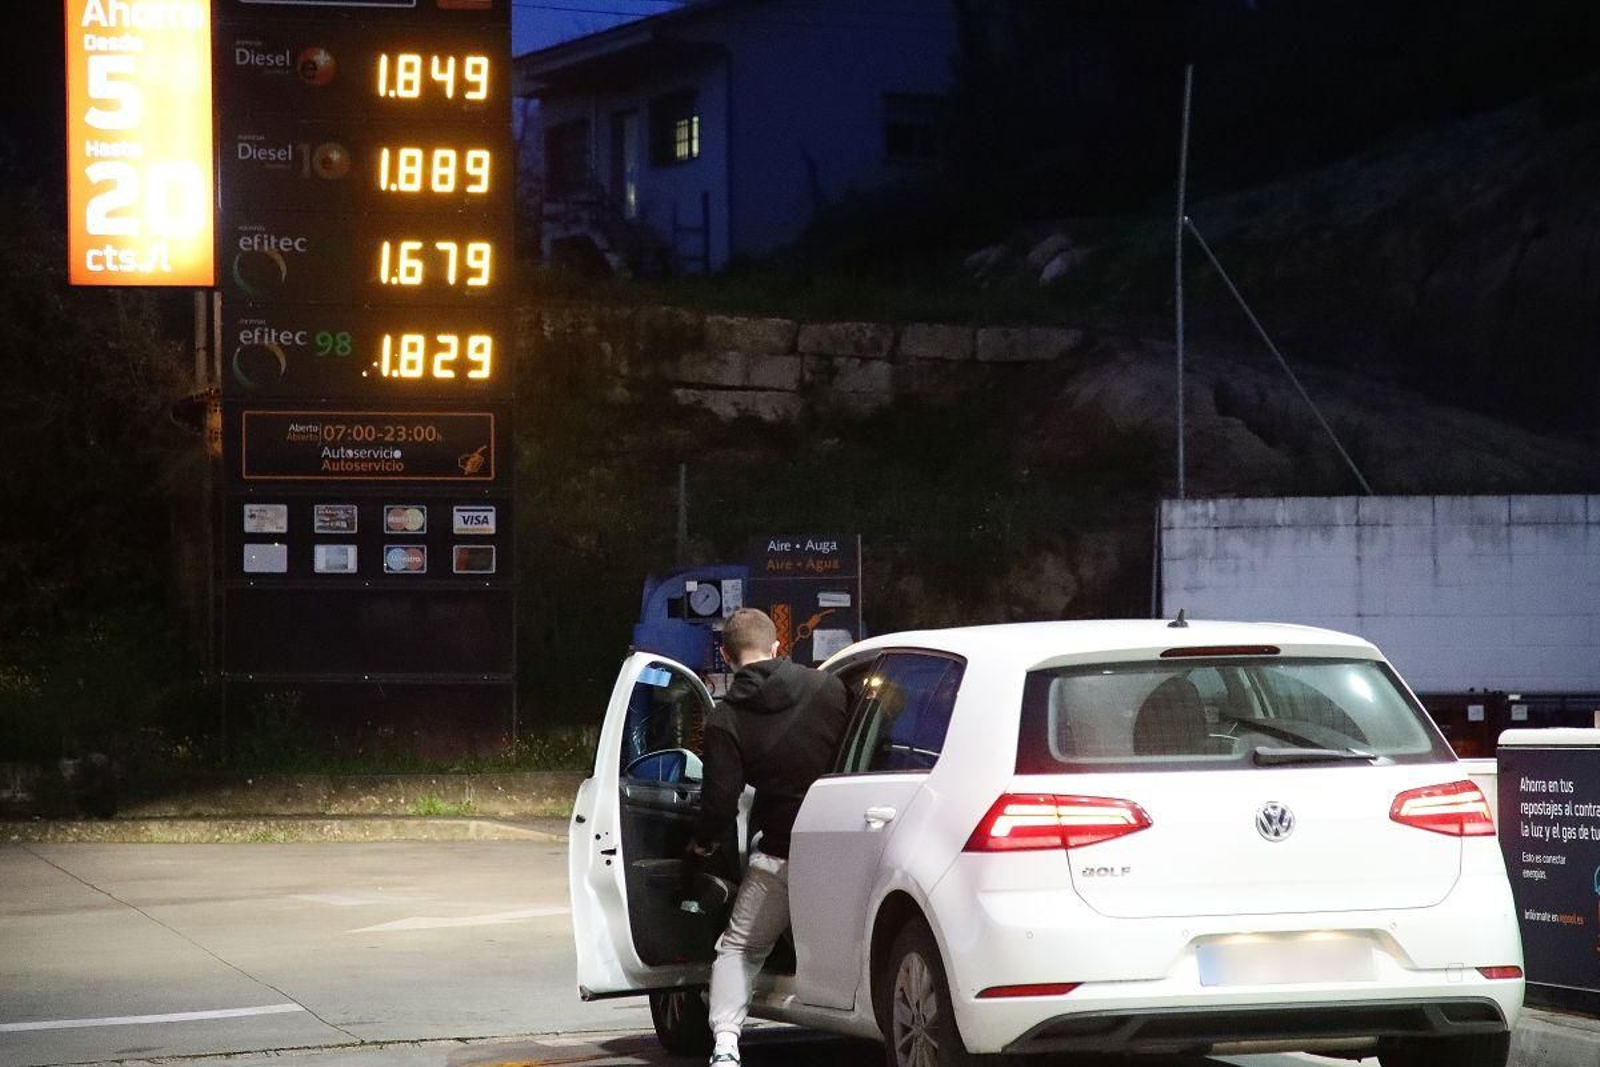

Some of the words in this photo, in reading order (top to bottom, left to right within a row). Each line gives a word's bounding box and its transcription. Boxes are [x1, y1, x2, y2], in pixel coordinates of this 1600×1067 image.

[235, 48, 291, 66] Diesel
[378, 53, 489, 100] 1.849
[84, 55, 142, 130] 5
[237, 142, 293, 161] Diesel
[379, 147, 490, 193] 1.889
[84, 160, 206, 237] 20
[239, 234, 308, 252] efitec
[380, 240, 491, 287] 1.679
[239, 327, 308, 346] efitec
[315, 331, 352, 356] 98
[381, 333, 492, 379] 1.829
[321, 446, 402, 459] Autoservicio
[321, 459, 405, 472] Autoservicio
[461, 515, 490, 526] VISA
[767, 540, 792, 552] Aire
[805, 539, 838, 554] Auga
[766, 559, 792, 570] Aire
[805, 559, 840, 573] Agua
[1520, 776, 1547, 792] Ahorra
[1548, 780, 1559, 792] en
[1560, 779, 1574, 793] tus
[1520, 800, 1563, 819] repostajes
[1564, 800, 1573, 816] al
[1520, 821, 1530, 837] la
[1530, 821, 1543, 838] luz
[1545, 826, 1550, 842] y
[1552, 822, 1560, 838] el
[1562, 826, 1576, 843] gas
[1578, 823, 1589, 840] de
[1082, 866, 1131, 878] GOLF
